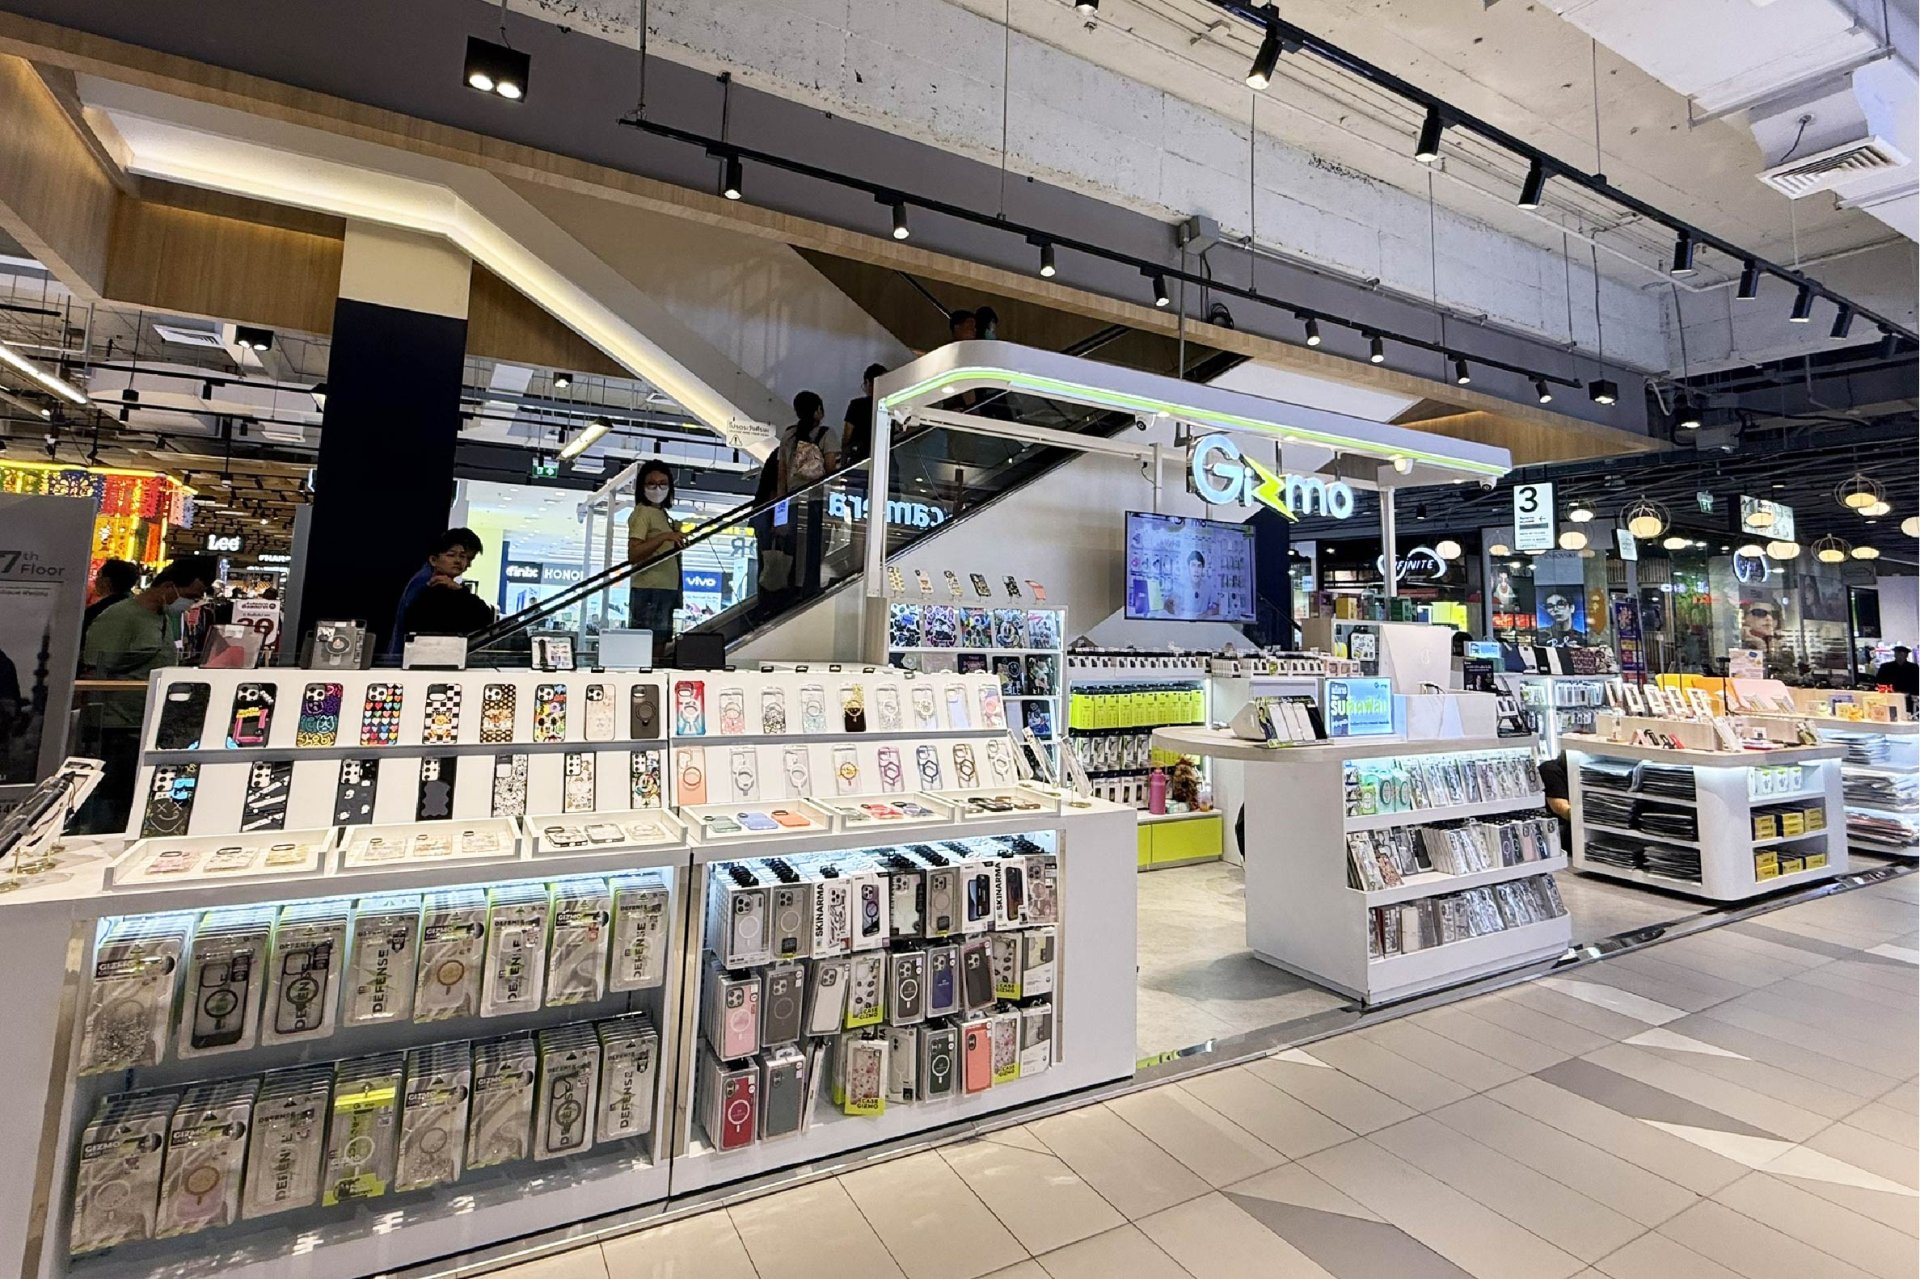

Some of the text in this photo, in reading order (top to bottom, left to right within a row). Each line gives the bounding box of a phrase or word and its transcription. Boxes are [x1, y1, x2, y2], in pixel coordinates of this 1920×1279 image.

[1519, 486, 1538, 513] 3
[207, 534, 241, 551] Lee
[21, 563, 65, 576] Floor
[544, 567, 584, 581] HONO
[686, 575, 717, 587] vivo
[815, 882, 824, 937] SKINARMA
[373, 949, 389, 1013] DEFENSE
[85, 1141, 120, 1153] GIZMO
